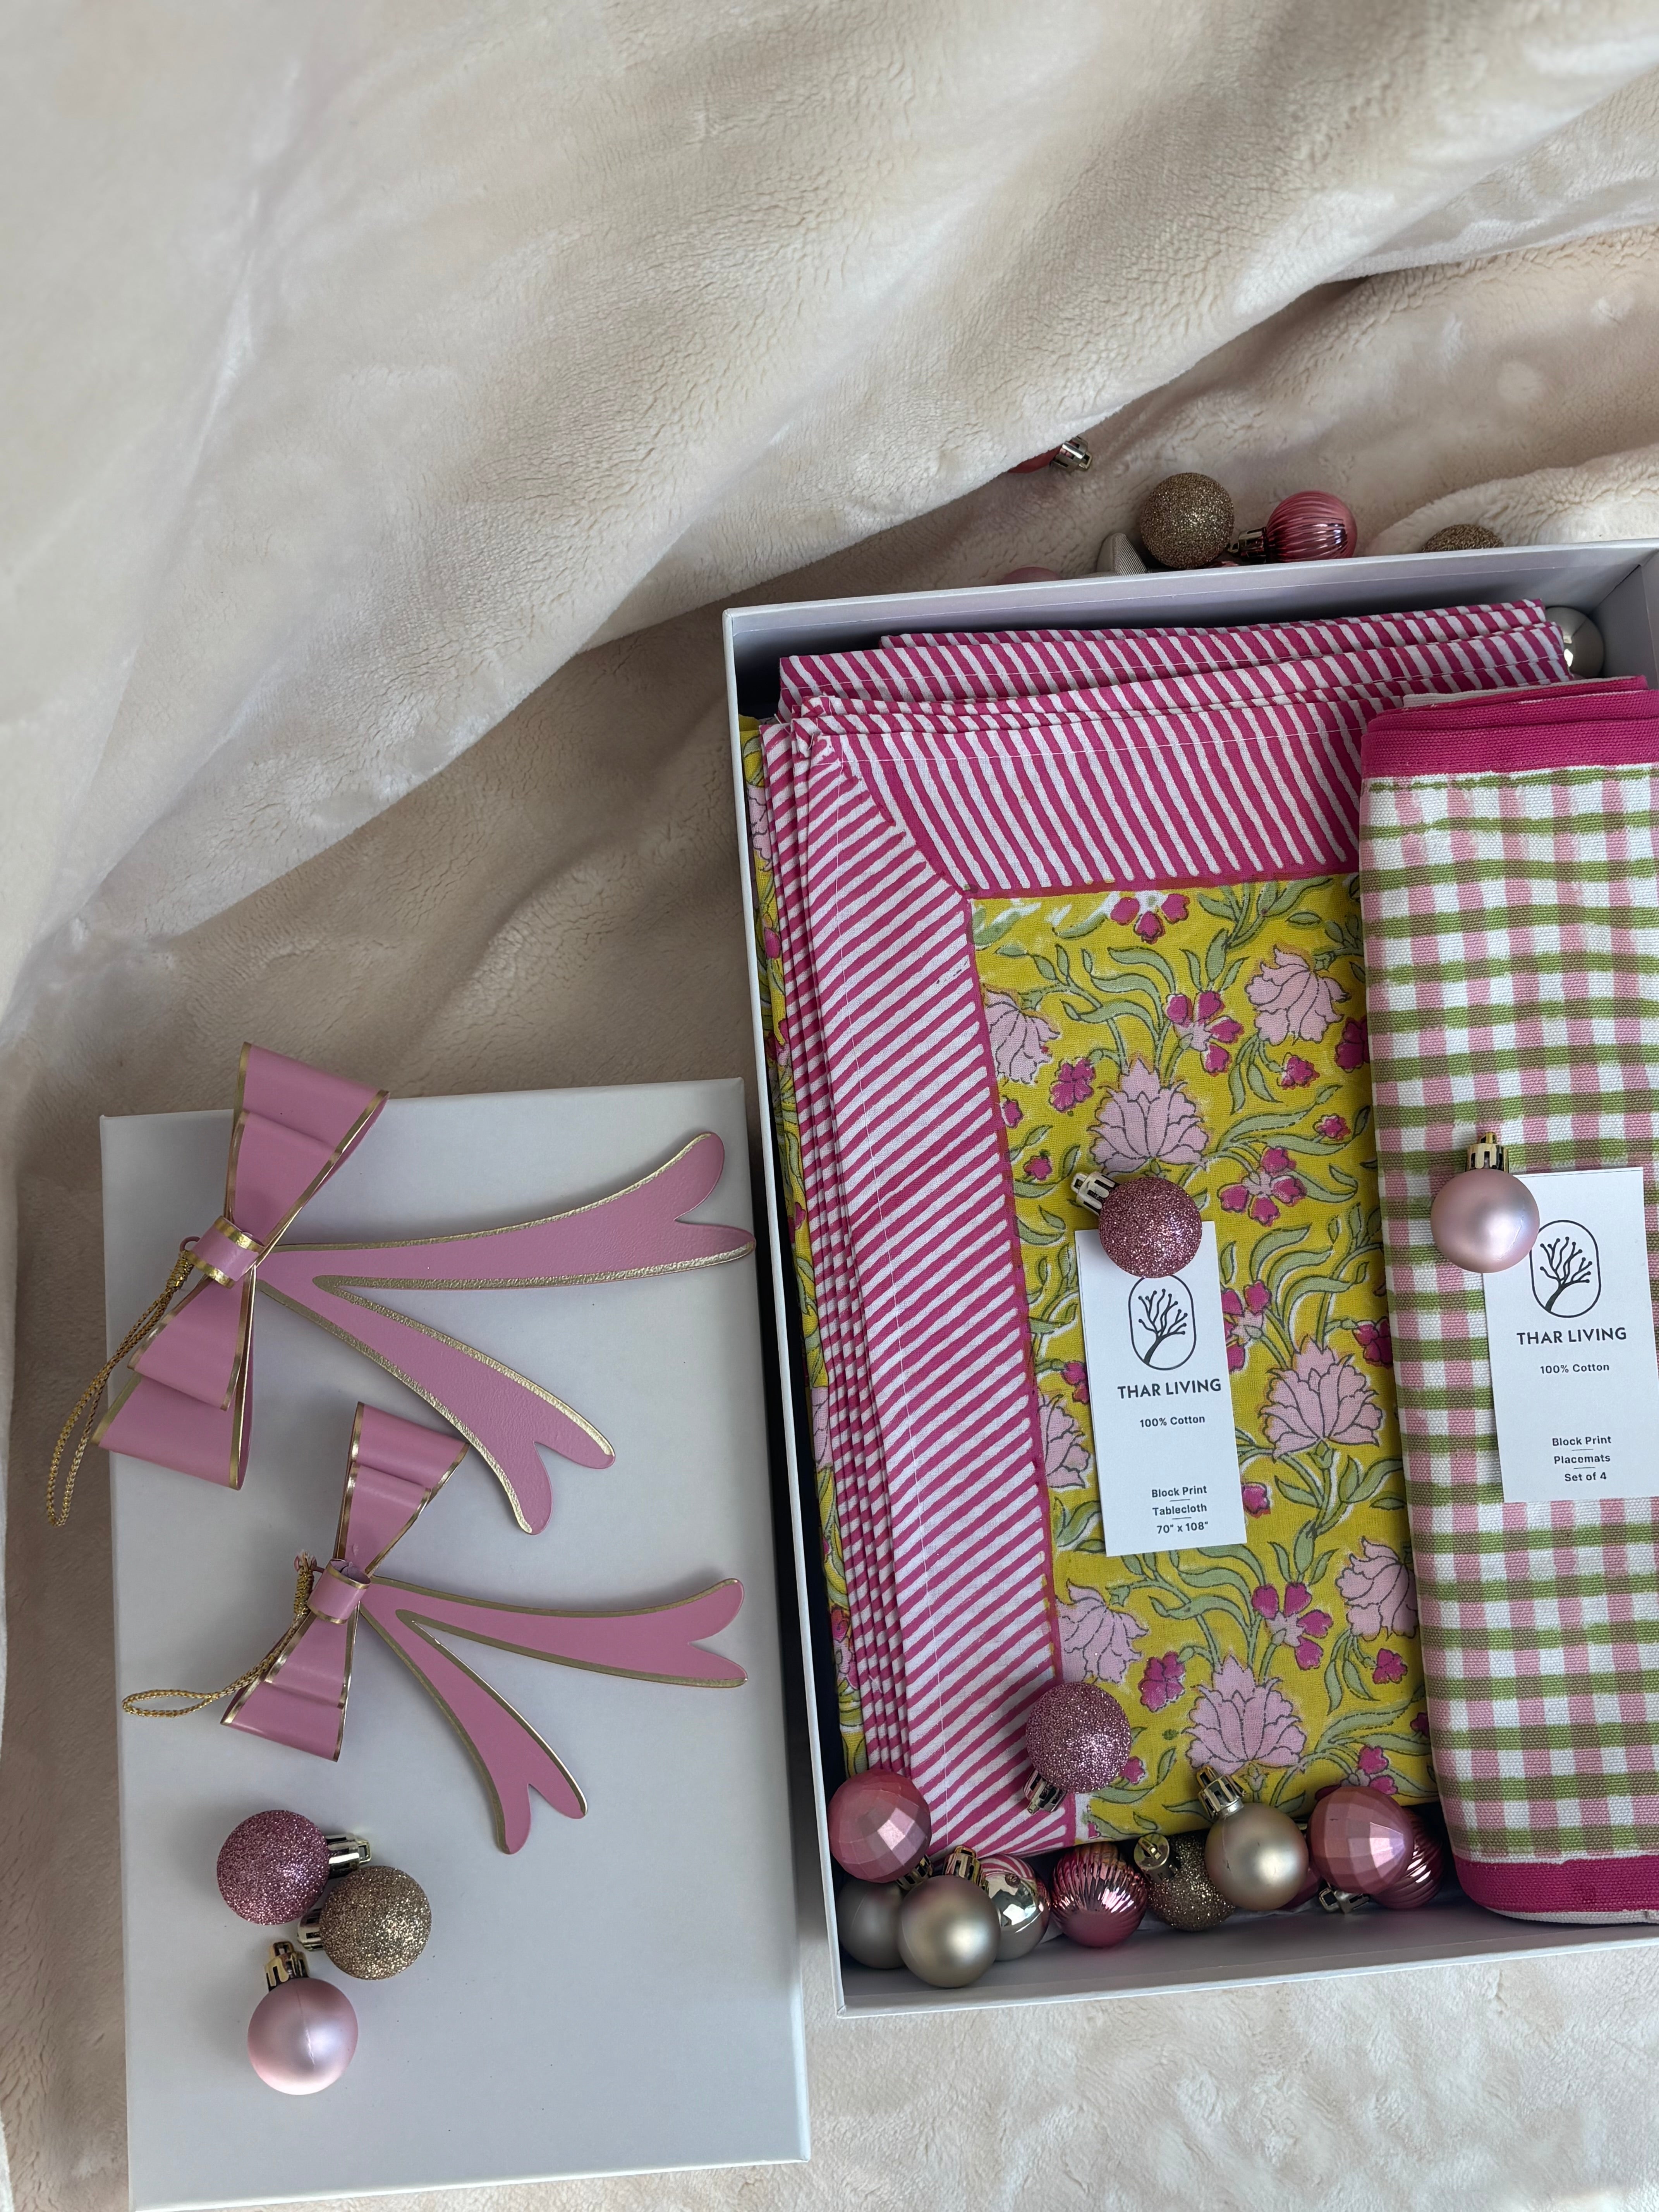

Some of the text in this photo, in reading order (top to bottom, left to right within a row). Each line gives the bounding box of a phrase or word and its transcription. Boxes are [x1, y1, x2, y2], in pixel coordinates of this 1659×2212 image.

[1516, 1327, 1626, 1345] THAR LIVING
[1540, 1364, 1609, 1374] 100% Cotton
[1117, 1378, 1221, 1399] THAR LIVING
[1140, 1416, 1205, 1427] 100% Cotton
[1552, 1436, 1611, 1446] Block Print
[1554, 1455, 1611, 1464] Placemats
[1565, 1474, 1582, 1482] Set
[1586, 1472, 1596, 1481] of
[1152, 1486, 1207, 1498] Block Print
[1152, 1503, 1207, 1516] Tablecloth
